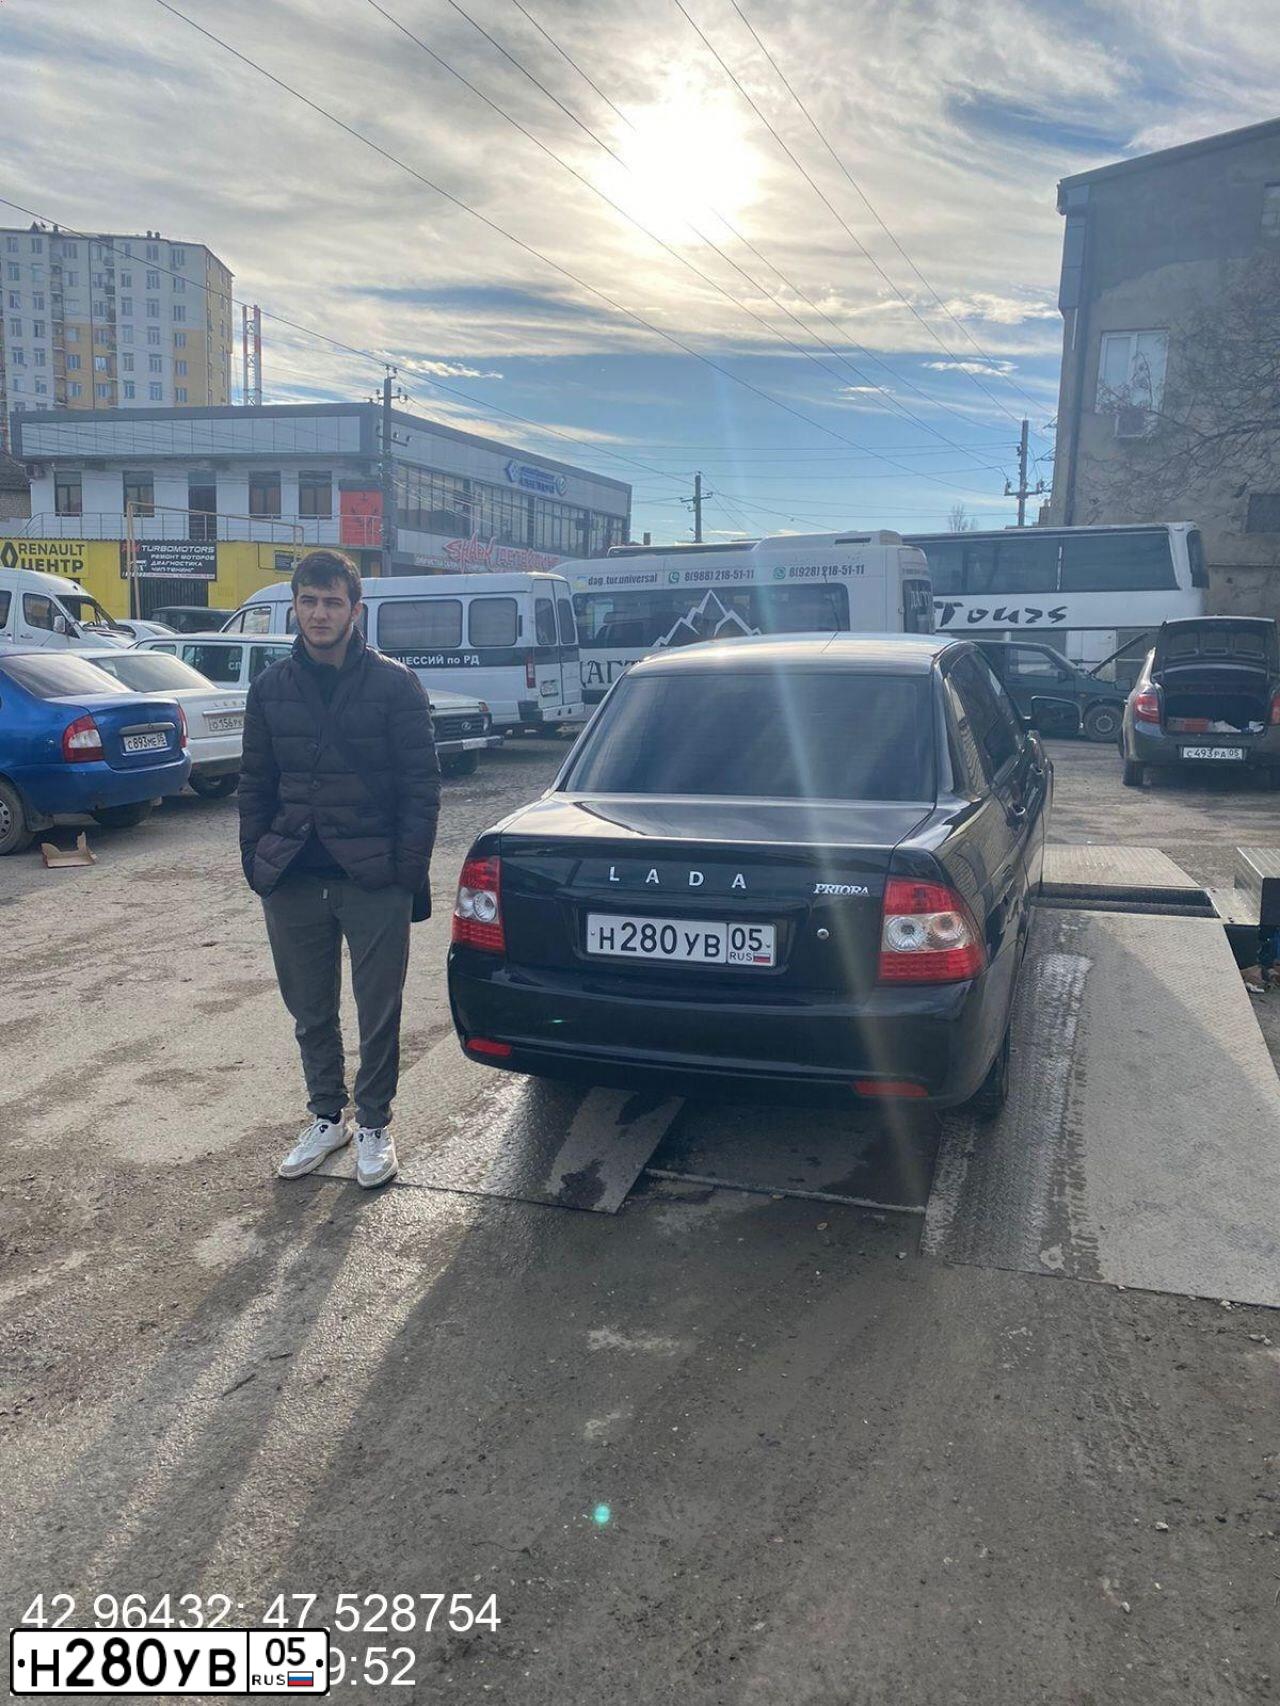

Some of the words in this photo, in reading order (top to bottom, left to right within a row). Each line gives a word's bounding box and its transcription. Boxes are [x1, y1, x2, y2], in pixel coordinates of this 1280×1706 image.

[18, 542, 85, 556] RENAULT
[141, 545, 215, 553] TURBOMOTORS
[20, 557, 84, 573] ЦЕНТР
[934, 601, 1068, 628] Tours
[463, 655, 480, 666] РД
[609, 866, 747, 889] LADA
[812, 883, 870, 897] PRIORA
[599, 921, 721, 958] Н280УВ
[731, 927, 763, 952] 05
[729, 951, 753, 962] RUS
